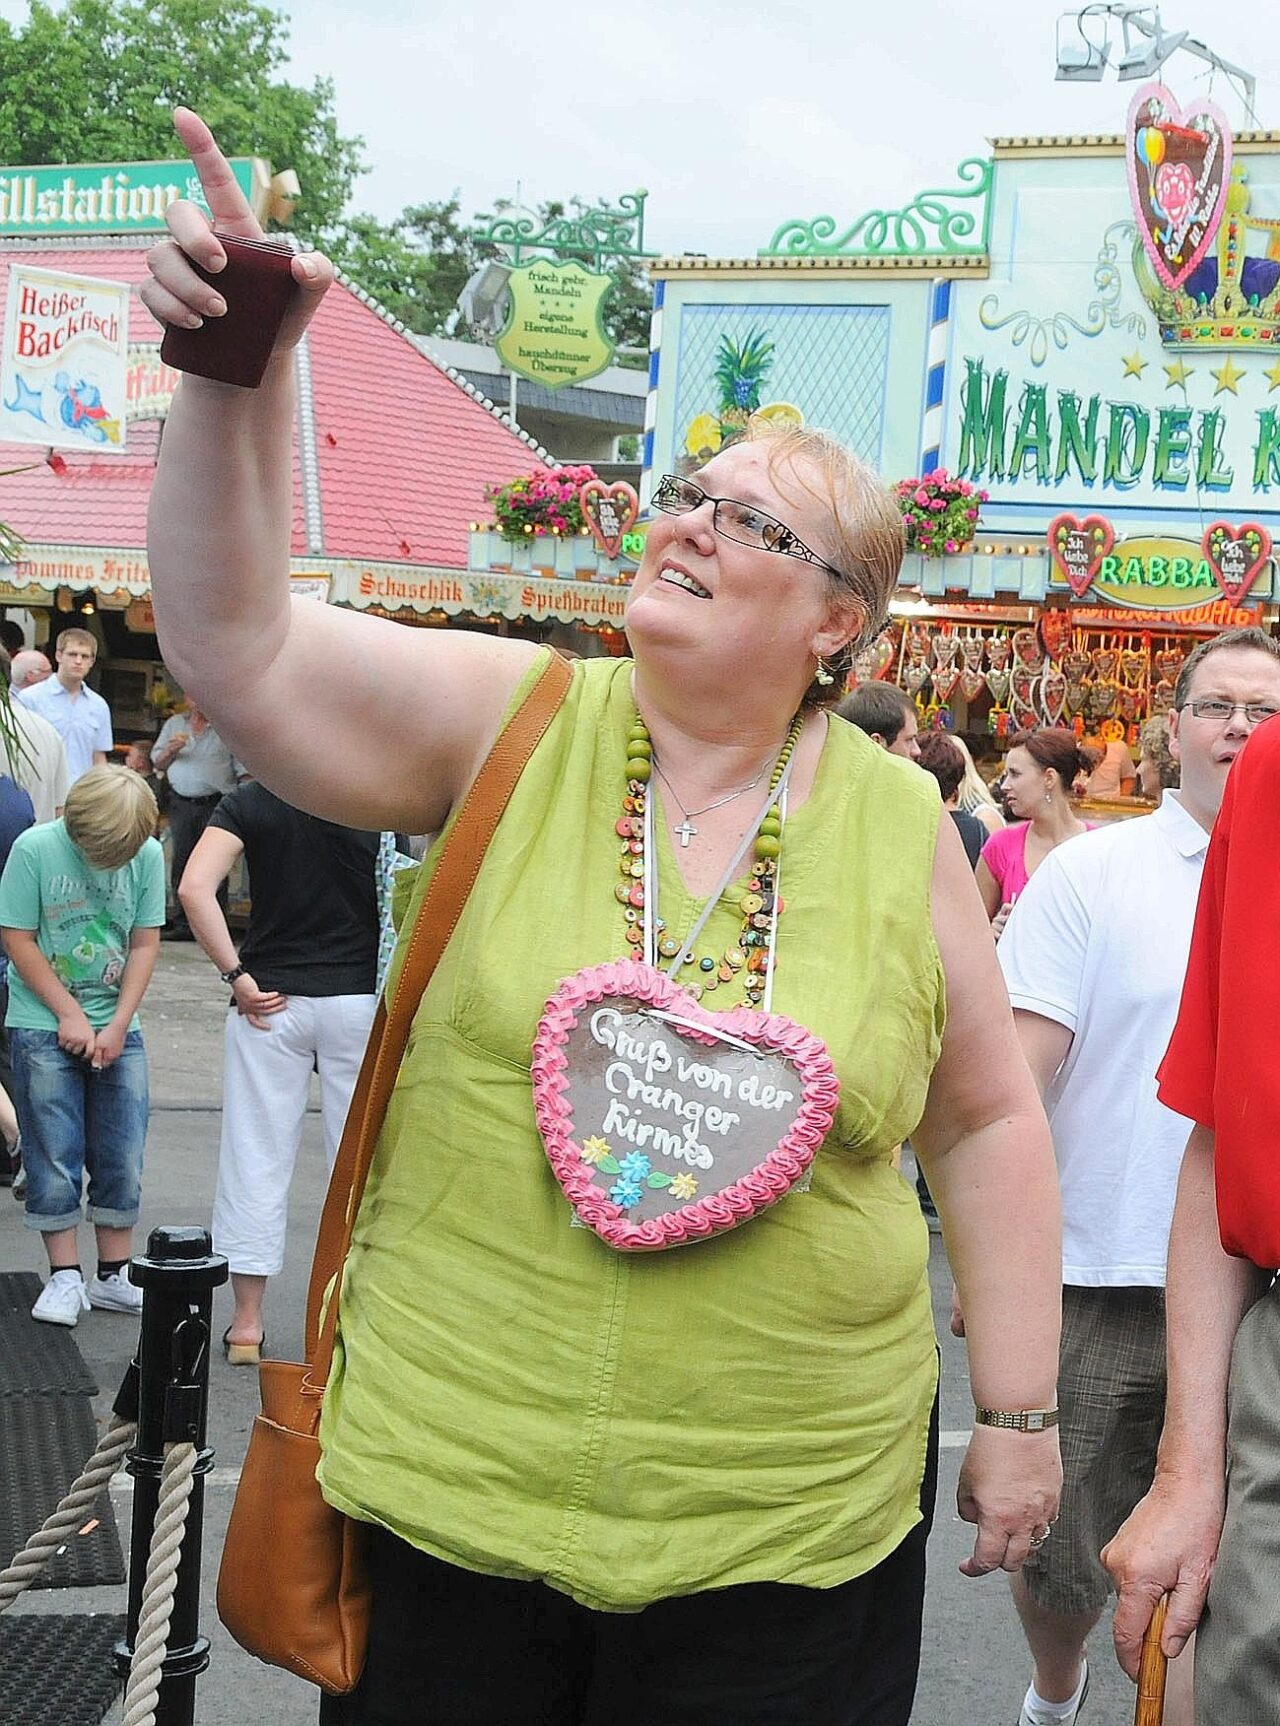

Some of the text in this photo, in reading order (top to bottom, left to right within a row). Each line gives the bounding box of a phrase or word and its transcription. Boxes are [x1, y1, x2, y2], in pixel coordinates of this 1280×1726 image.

[528, 270, 559, 282] frisch
[534, 284, 582, 298] Mandeln
[20, 286, 86, 320] Heißer
[539, 310, 575, 323] eigene
[17, 310, 118, 358] Backfisch
[524, 321, 589, 338] Herstellung
[531, 360, 578, 376] Überzug
[958, 356, 1234, 493] MANDEL
[359, 571, 463, 604] Schaschlik
[521, 585, 625, 616] Spießbraten
[589, 1007, 794, 1111] Gruß von der
[605, 1061, 741, 1138] Cranger
